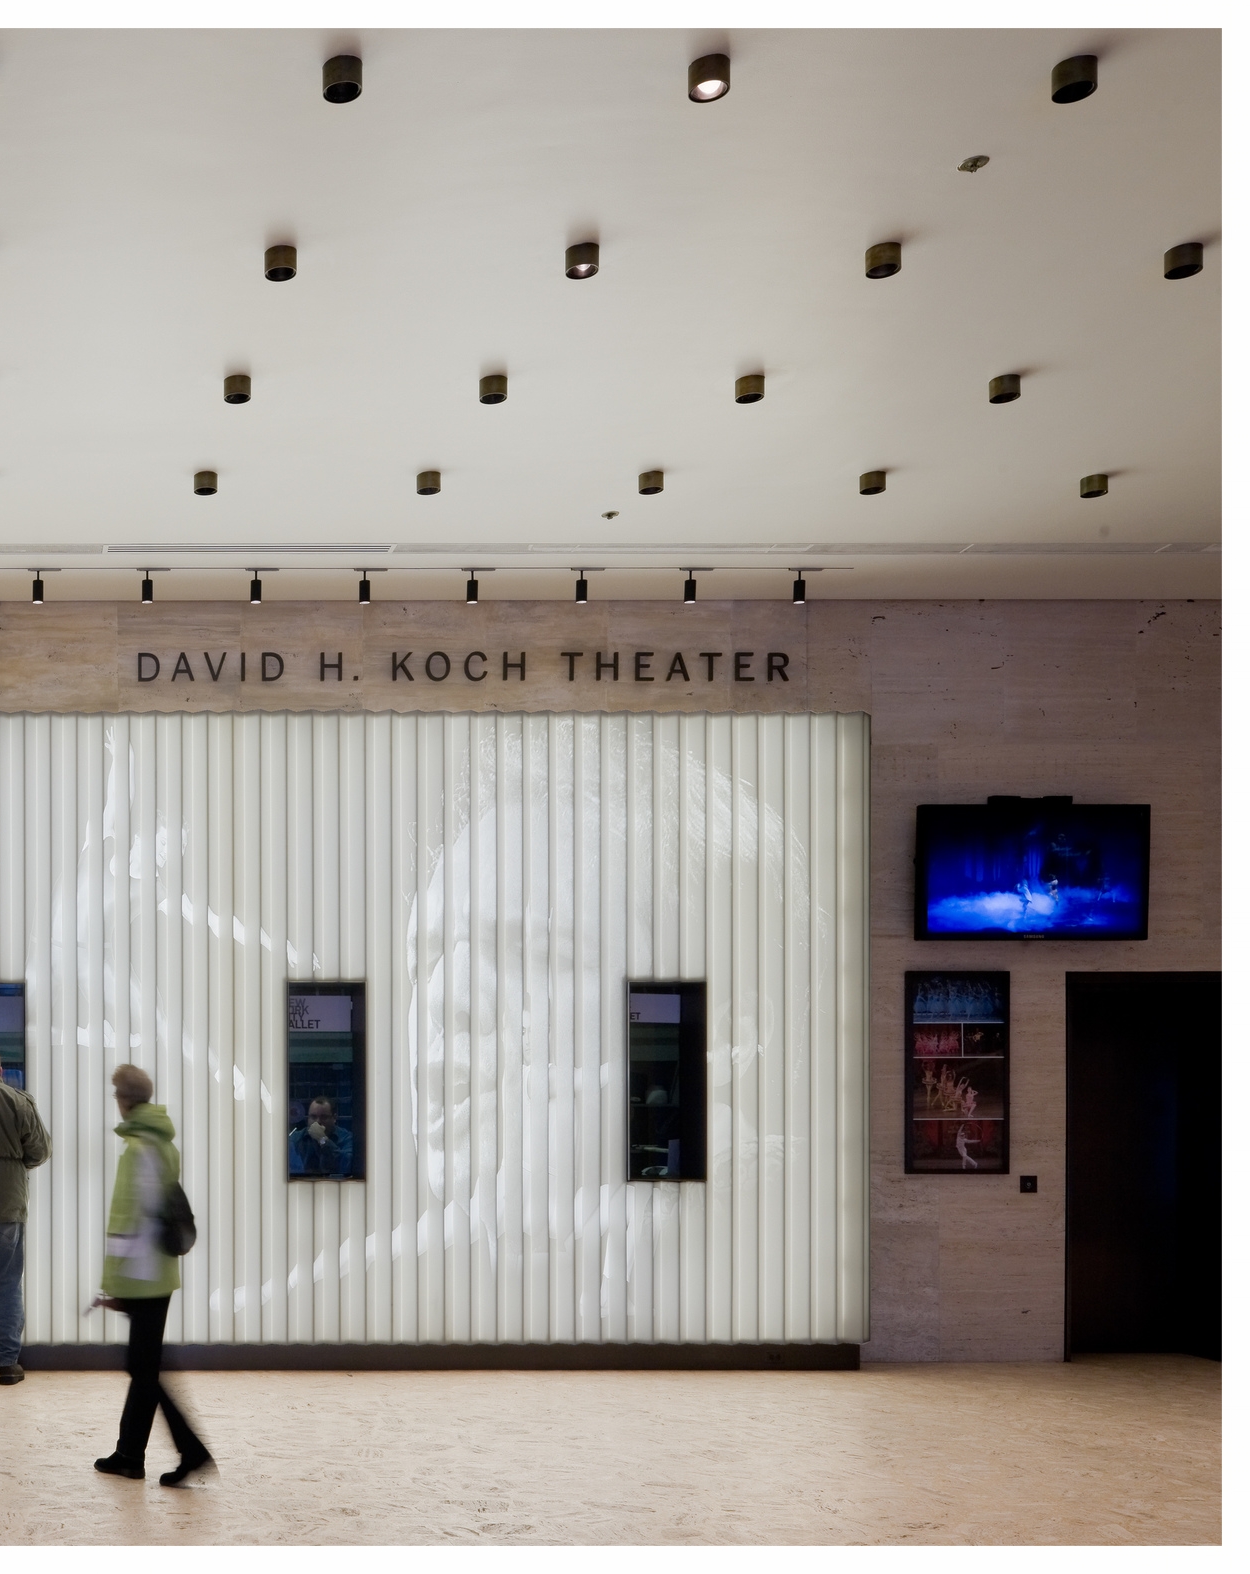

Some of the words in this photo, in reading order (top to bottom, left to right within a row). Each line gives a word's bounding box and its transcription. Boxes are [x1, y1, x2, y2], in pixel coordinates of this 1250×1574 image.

[137, 651, 285, 682] DAVID
[319, 651, 359, 682] H.
[391, 651, 526, 682] KOCH
[560, 651, 790, 682] THEATER
[289, 998, 306, 1007] EW
[289, 1005, 309, 1015] ORK
[289, 1020, 321, 1029] ALLET
